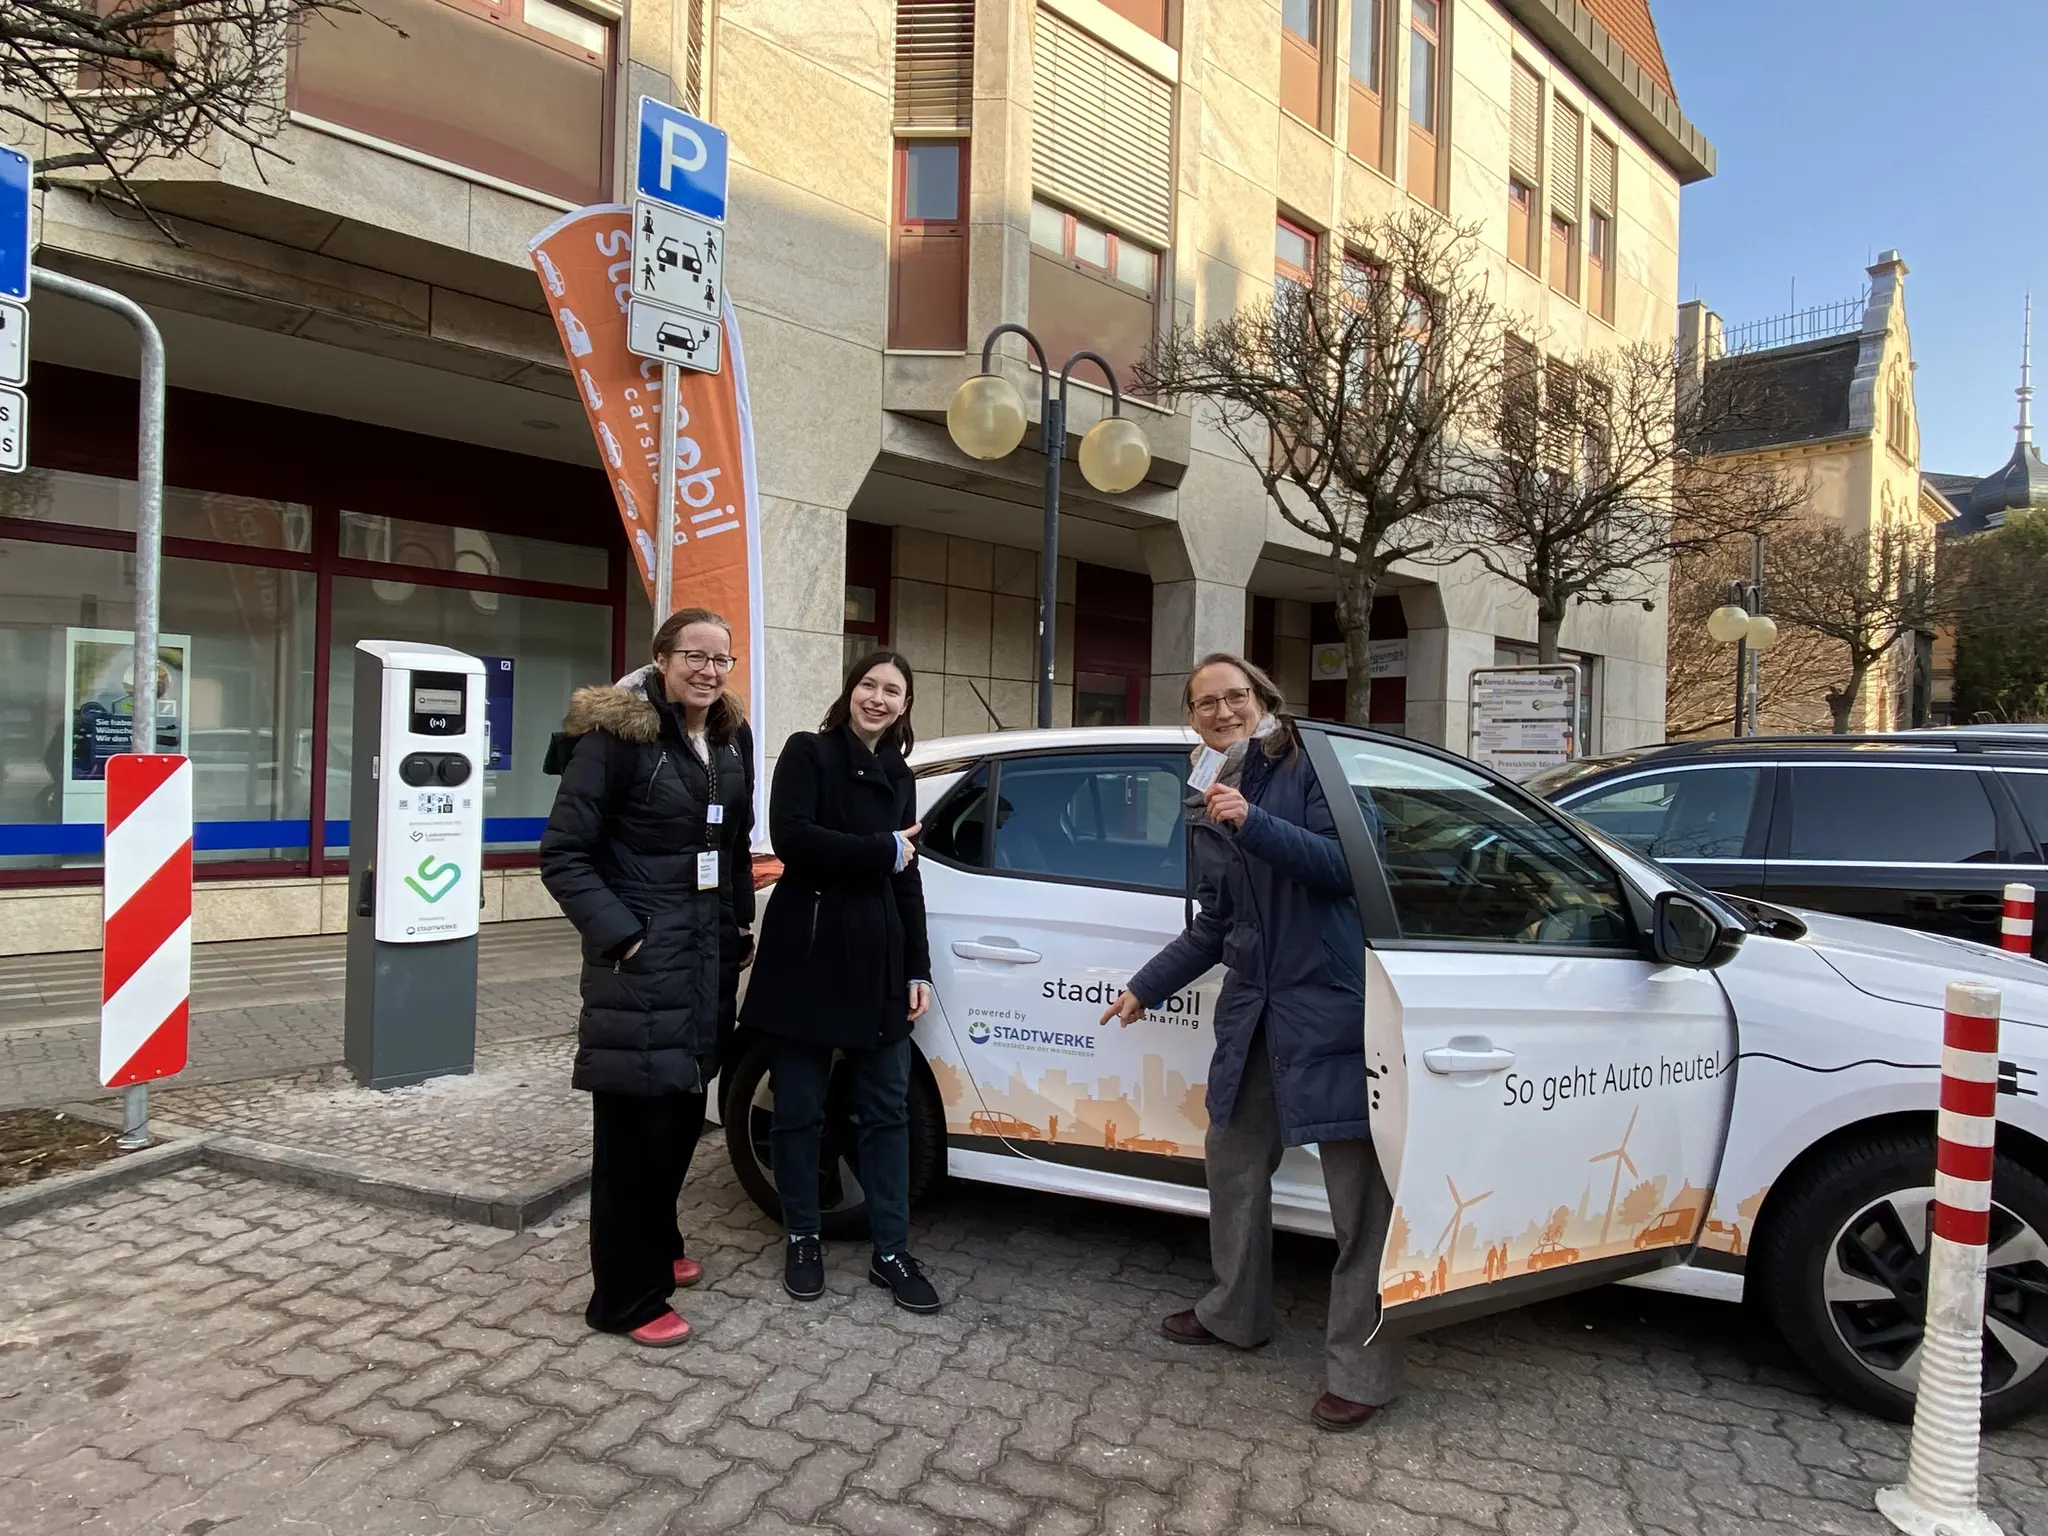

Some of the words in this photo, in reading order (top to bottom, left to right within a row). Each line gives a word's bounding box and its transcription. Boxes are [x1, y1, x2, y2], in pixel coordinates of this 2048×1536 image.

[660, 117, 708, 192] P
[95, 718, 109, 726] Sie
[110, 718, 133, 726] habe
[95, 734, 111, 742] Wir
[968, 1008, 1011, 1019] powered
[1014, 1011, 1026, 1021] by
[993, 1026, 1095, 1049] STADTWERKE
[1503, 1073, 1534, 1106] So
[1542, 1065, 1597, 1111] geht
[1602, 1062, 1653, 1094] Auto
[1660, 1050, 1719, 1086] heute!
